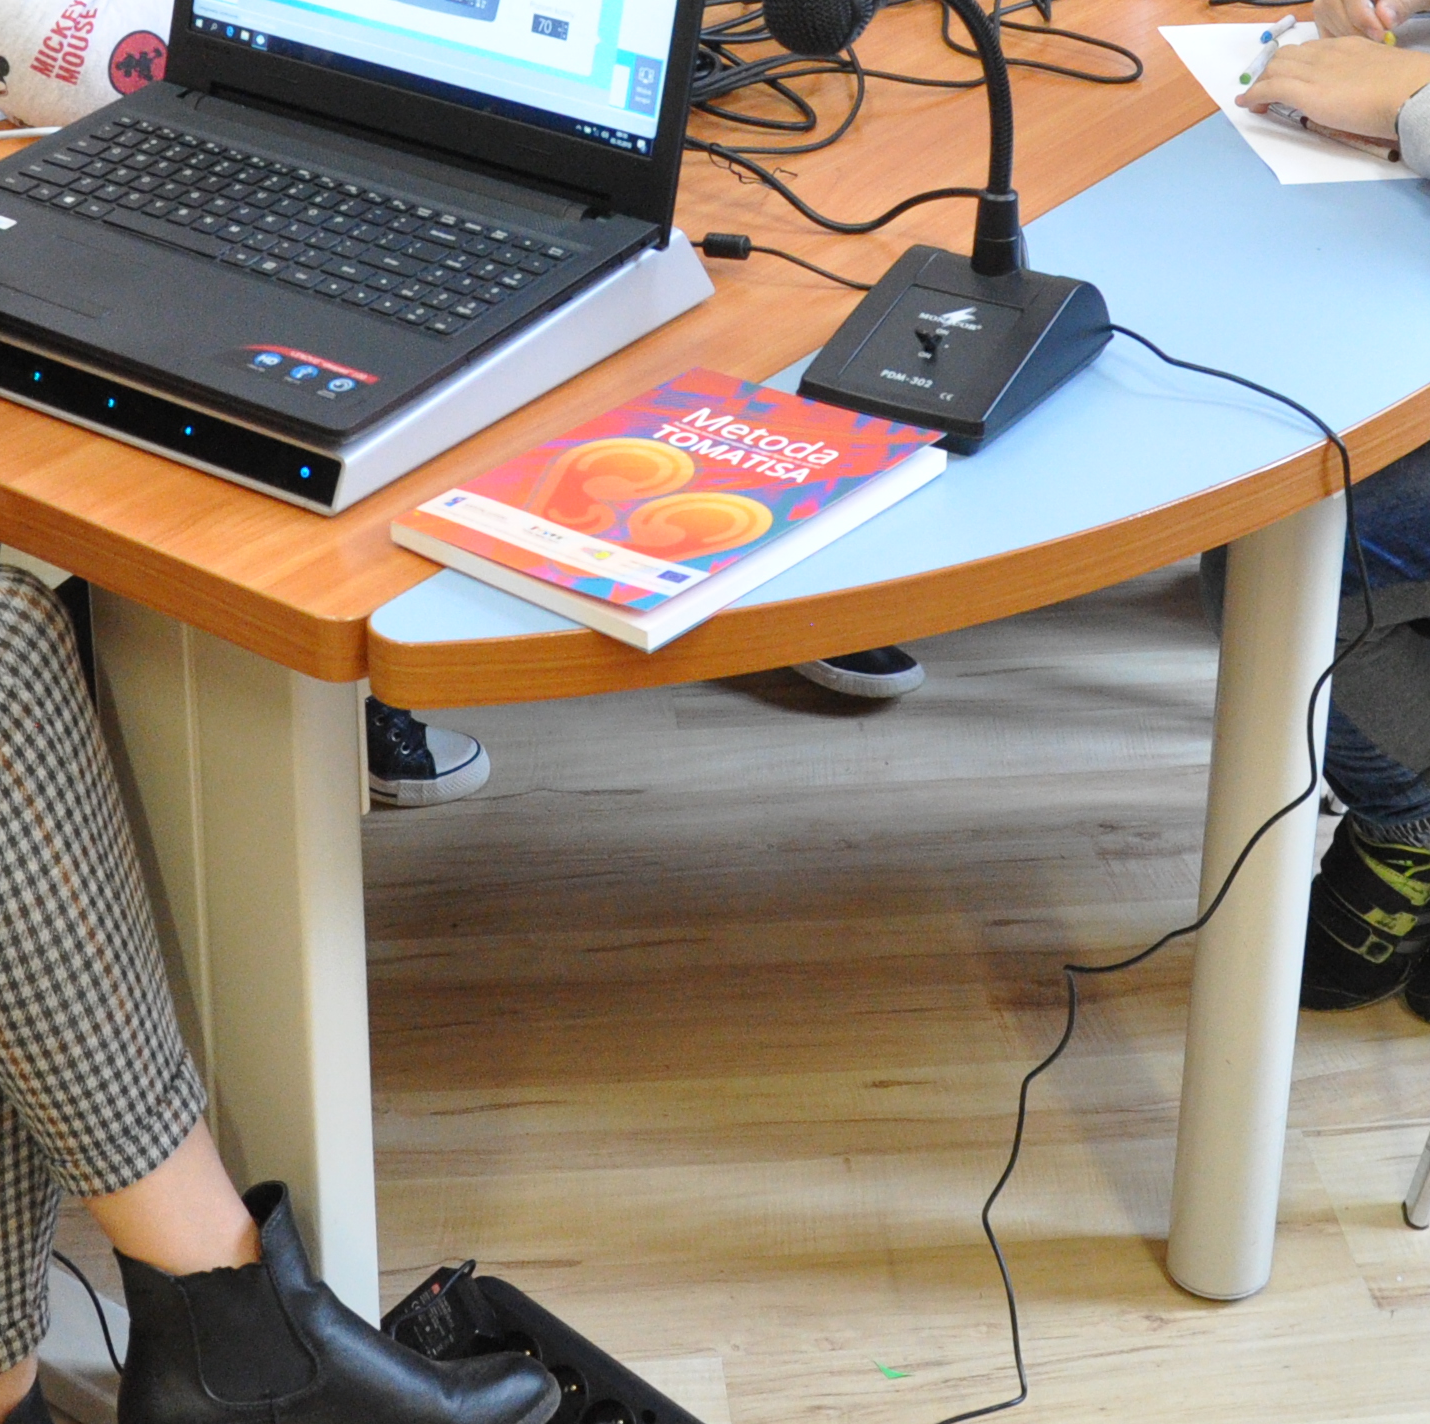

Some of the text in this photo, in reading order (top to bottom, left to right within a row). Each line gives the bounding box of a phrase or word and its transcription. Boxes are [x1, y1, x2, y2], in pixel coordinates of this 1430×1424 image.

[53, 6, 98, 86] MOUSE
[538, 17, 553, 34] 70
[880, 368, 933, 389] PDM-302
[652, 423, 811, 483] TOMATISA
[682, 407, 839, 465] Metoda
